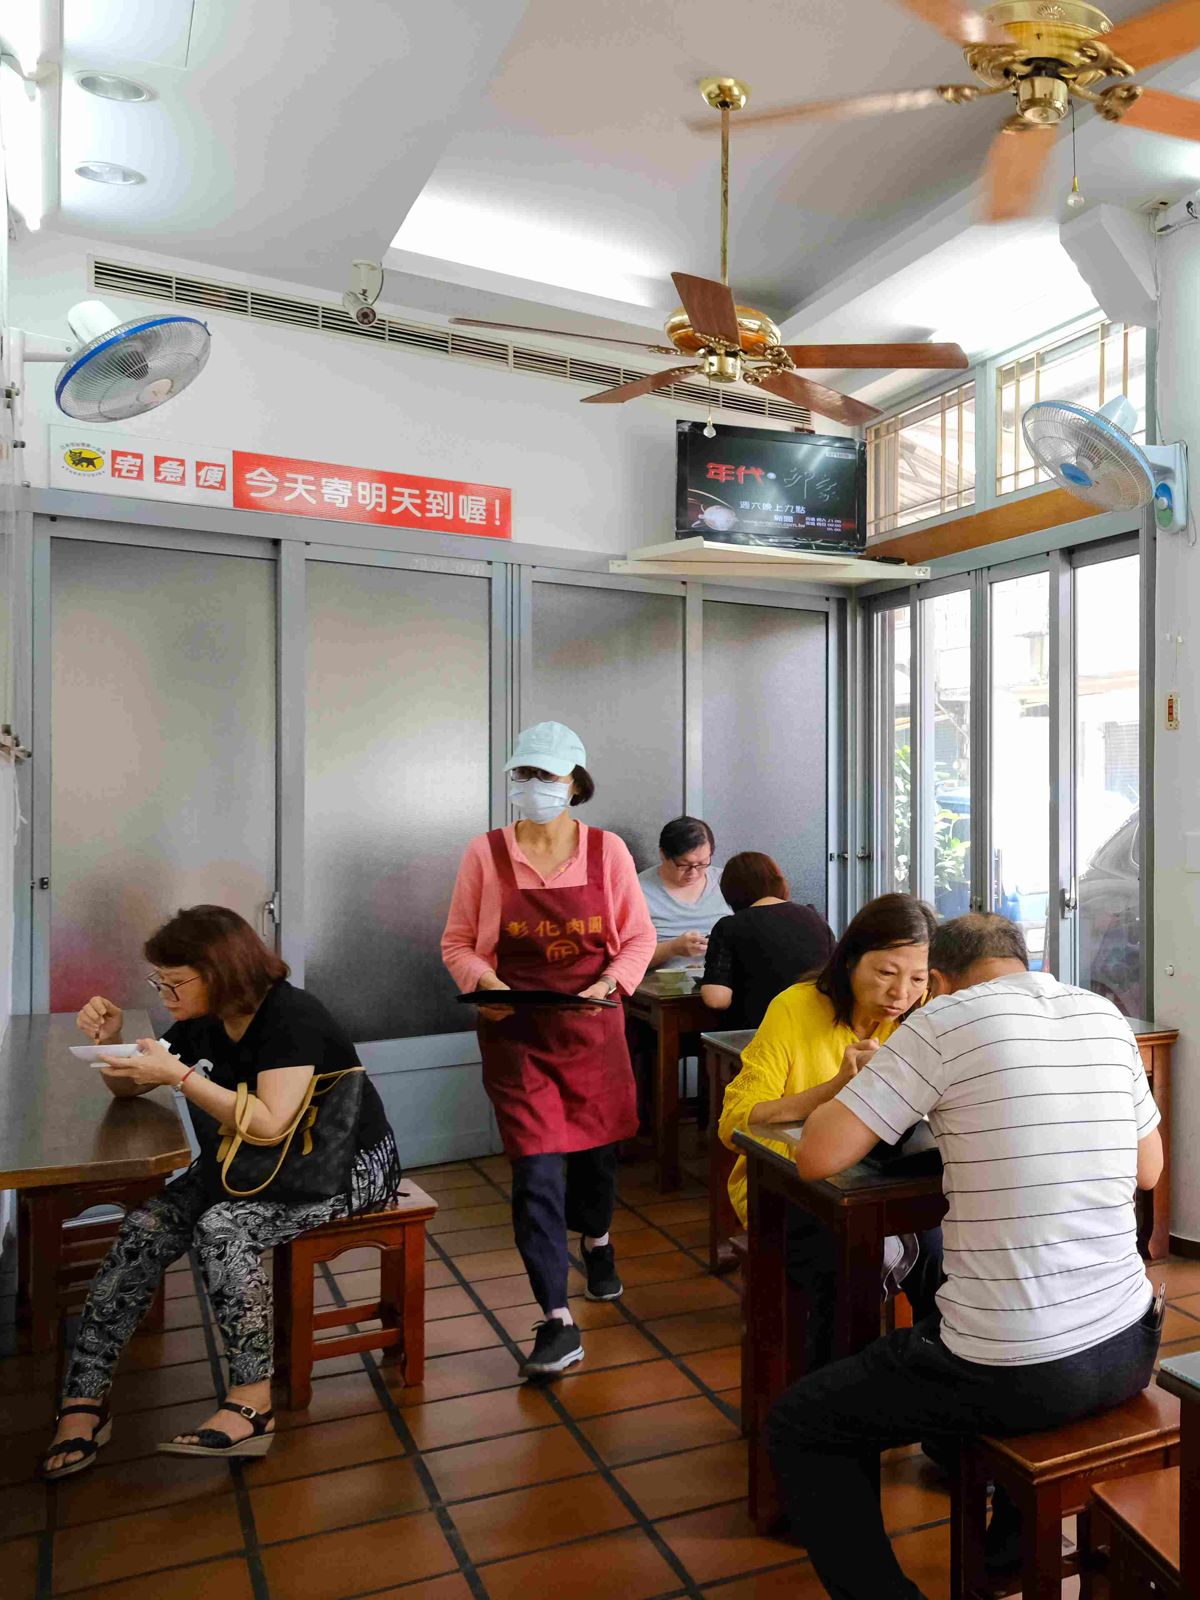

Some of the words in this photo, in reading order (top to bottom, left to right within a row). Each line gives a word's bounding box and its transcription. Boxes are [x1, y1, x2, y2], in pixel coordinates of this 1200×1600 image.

[113, 455, 225, 488] 宅急便
[706, 462, 765, 484] 年代
[244, 466, 501, 526] 今天寄明天到喔!
[504, 916, 604, 938] 彰化肉圓
